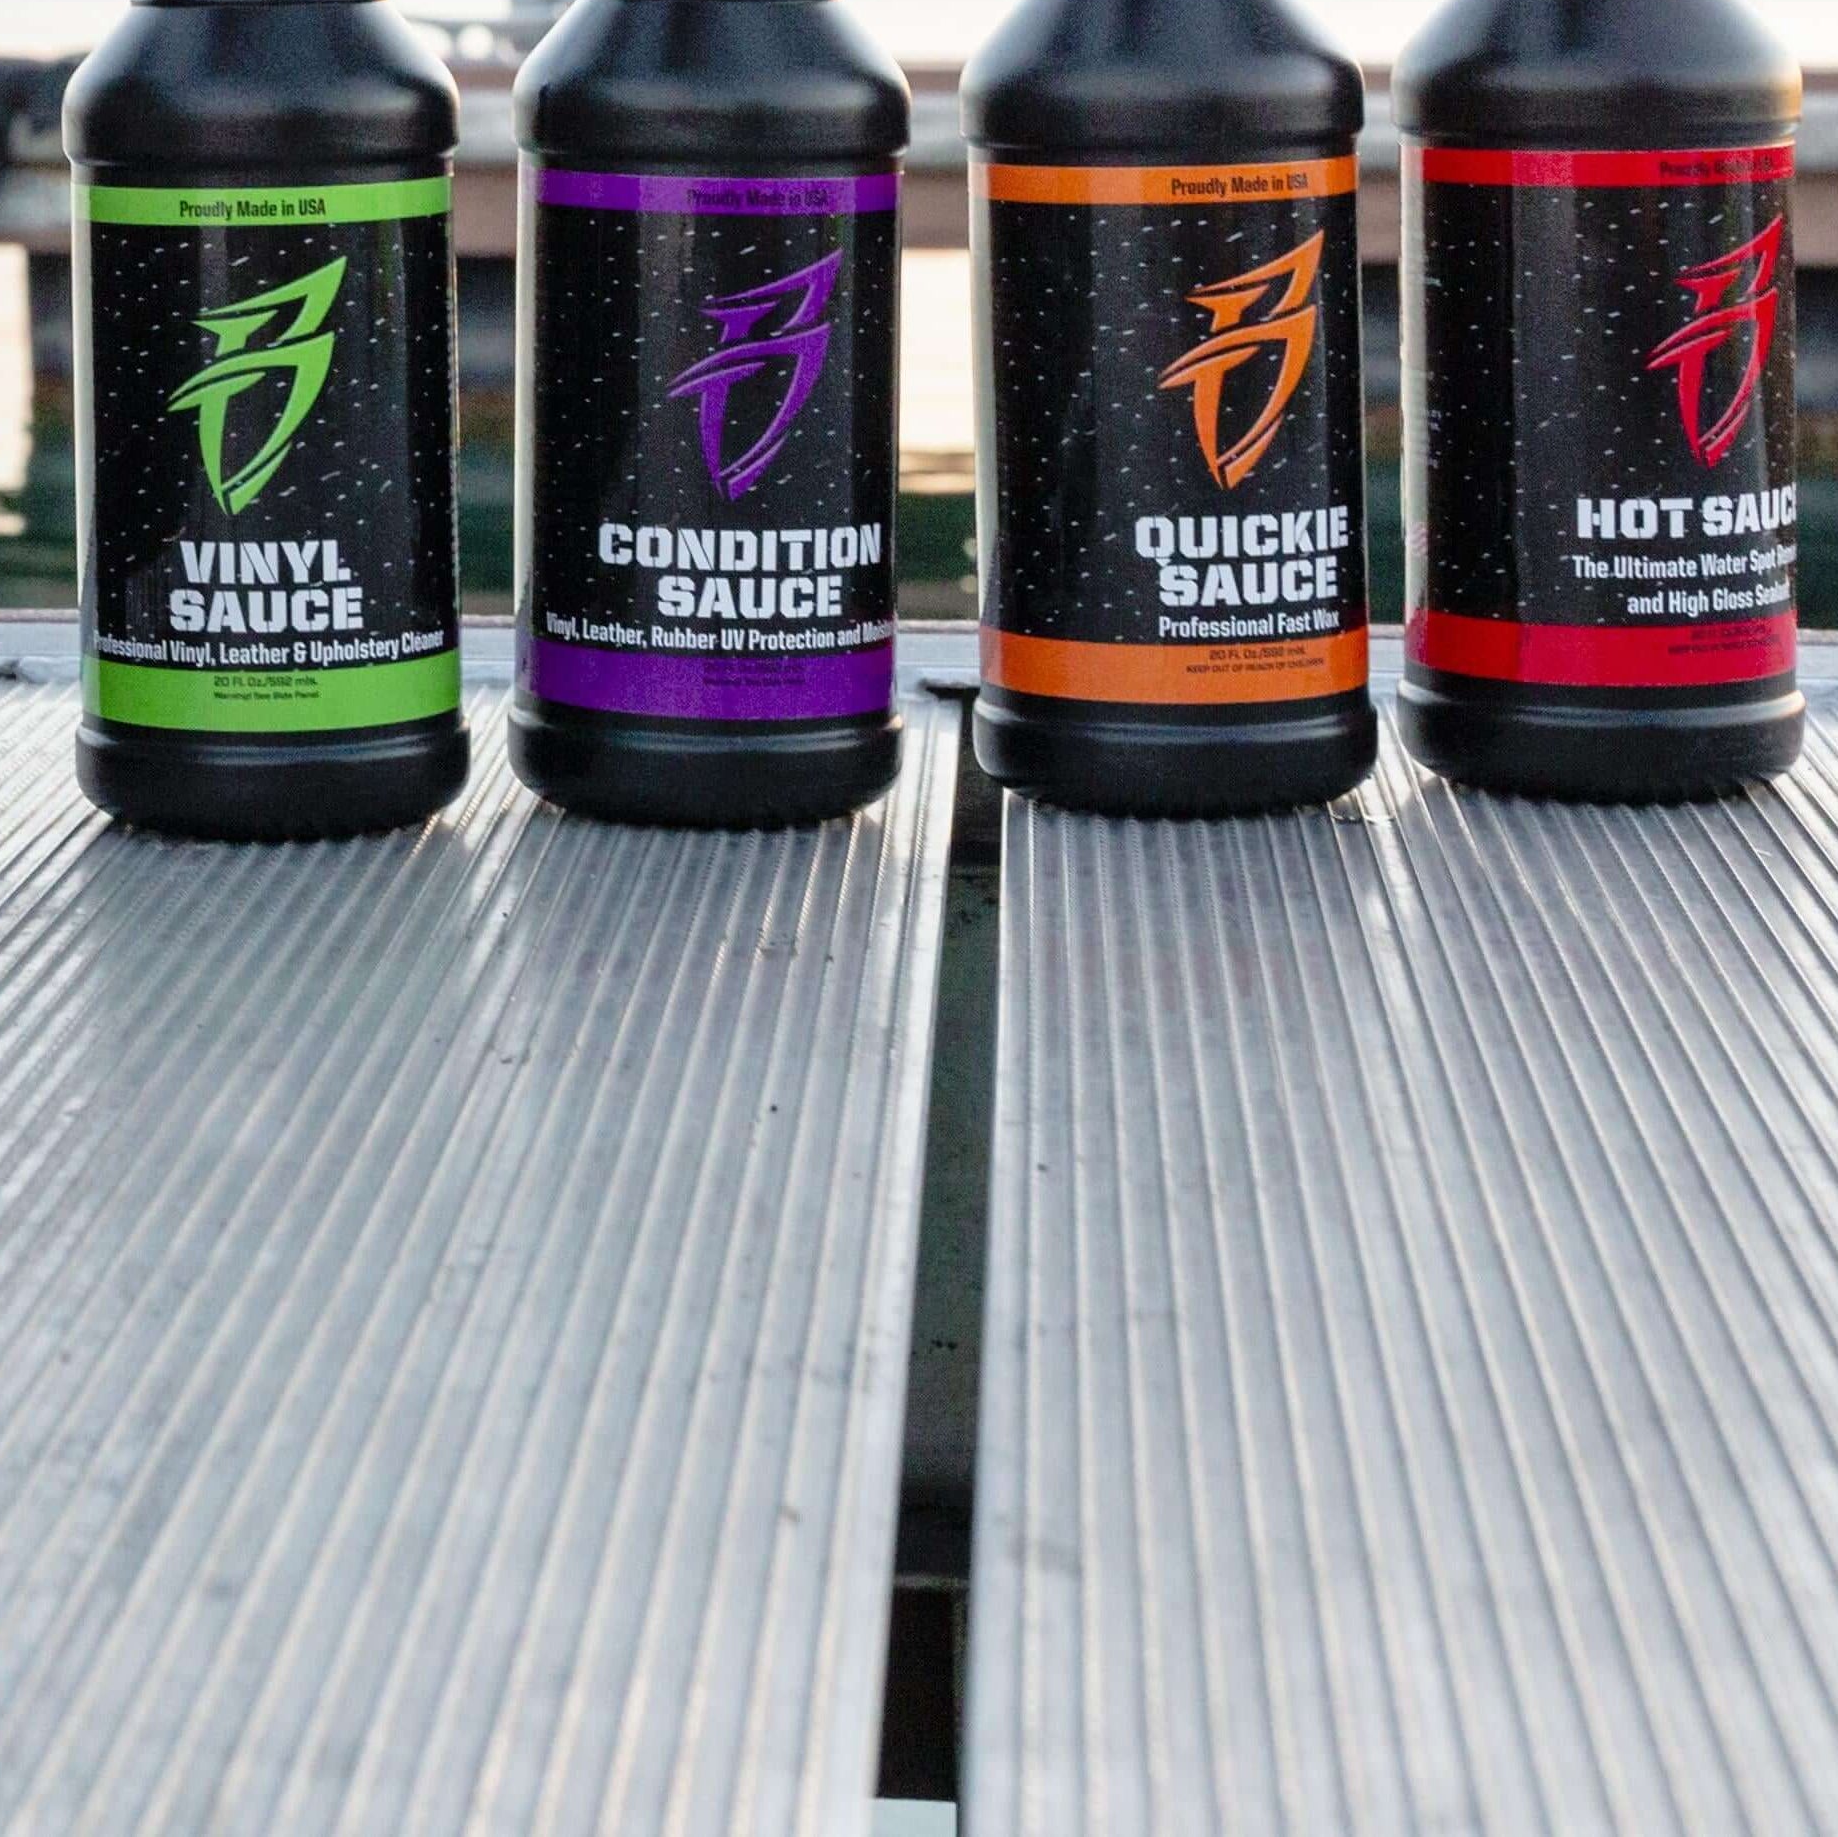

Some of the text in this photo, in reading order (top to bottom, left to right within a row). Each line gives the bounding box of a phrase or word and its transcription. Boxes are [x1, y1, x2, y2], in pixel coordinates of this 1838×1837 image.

[1171, 172, 1309, 197] Proudly Made in USA
[179, 198, 327, 220] Proudly Made in USA
[1134, 505, 1349, 567] QUICKIE
[1576, 497, 1694, 540] HOT
[179, 539, 352, 585] VINYL
[598, 522, 881, 571] CONDITION
[1572, 555, 1610, 579] The
[1613, 555, 1698, 579] Ultimate
[1699, 552, 1749, 577] Water
[1749, 547, 1776, 575] Spot
[657, 574, 843, 619] SAUCE
[1158, 556, 1338, 607] SAUCE
[169, 587, 364, 633] SAUCE
[1158, 608, 1340, 639] Professional Fast Wax
[1627, 591, 1664, 615] and
[1667, 590, 1710, 618] High
[1712, 588, 1755, 612] Gloss
[169, 639, 216, 667] Vinyl,
[219, 642, 290, 665] Leather
[293, 641, 308, 664] &
[311, 637, 400, 667] Upholstery
[401, 629, 445, 654] Cleaner
[546, 611, 581, 641] Vinyl,
[582, 618, 648, 649] Leather,
[651, 625, 717, 650] Rubber
[720, 627, 746, 651] UV
[748, 627, 835, 650] Protection
[837, 622, 861, 645] and
